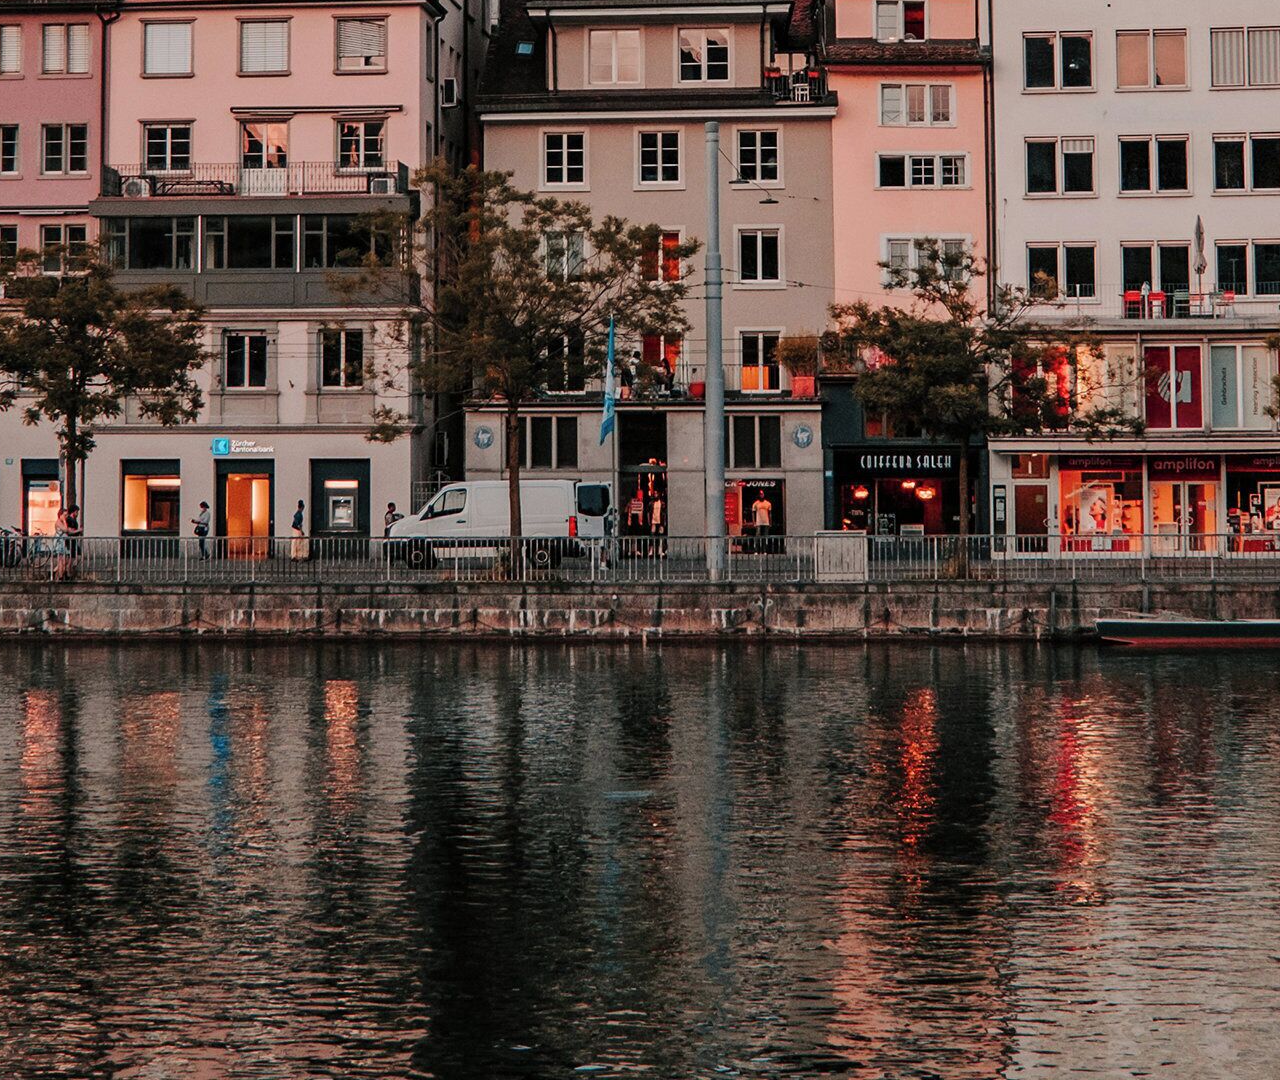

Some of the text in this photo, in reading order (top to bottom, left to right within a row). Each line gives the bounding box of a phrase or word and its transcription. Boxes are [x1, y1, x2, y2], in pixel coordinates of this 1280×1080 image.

[860, 455, 912, 469] COIFFEUR
[1068, 458, 1112, 468] amplifon
[1153, 459, 1215, 473] amplifon
